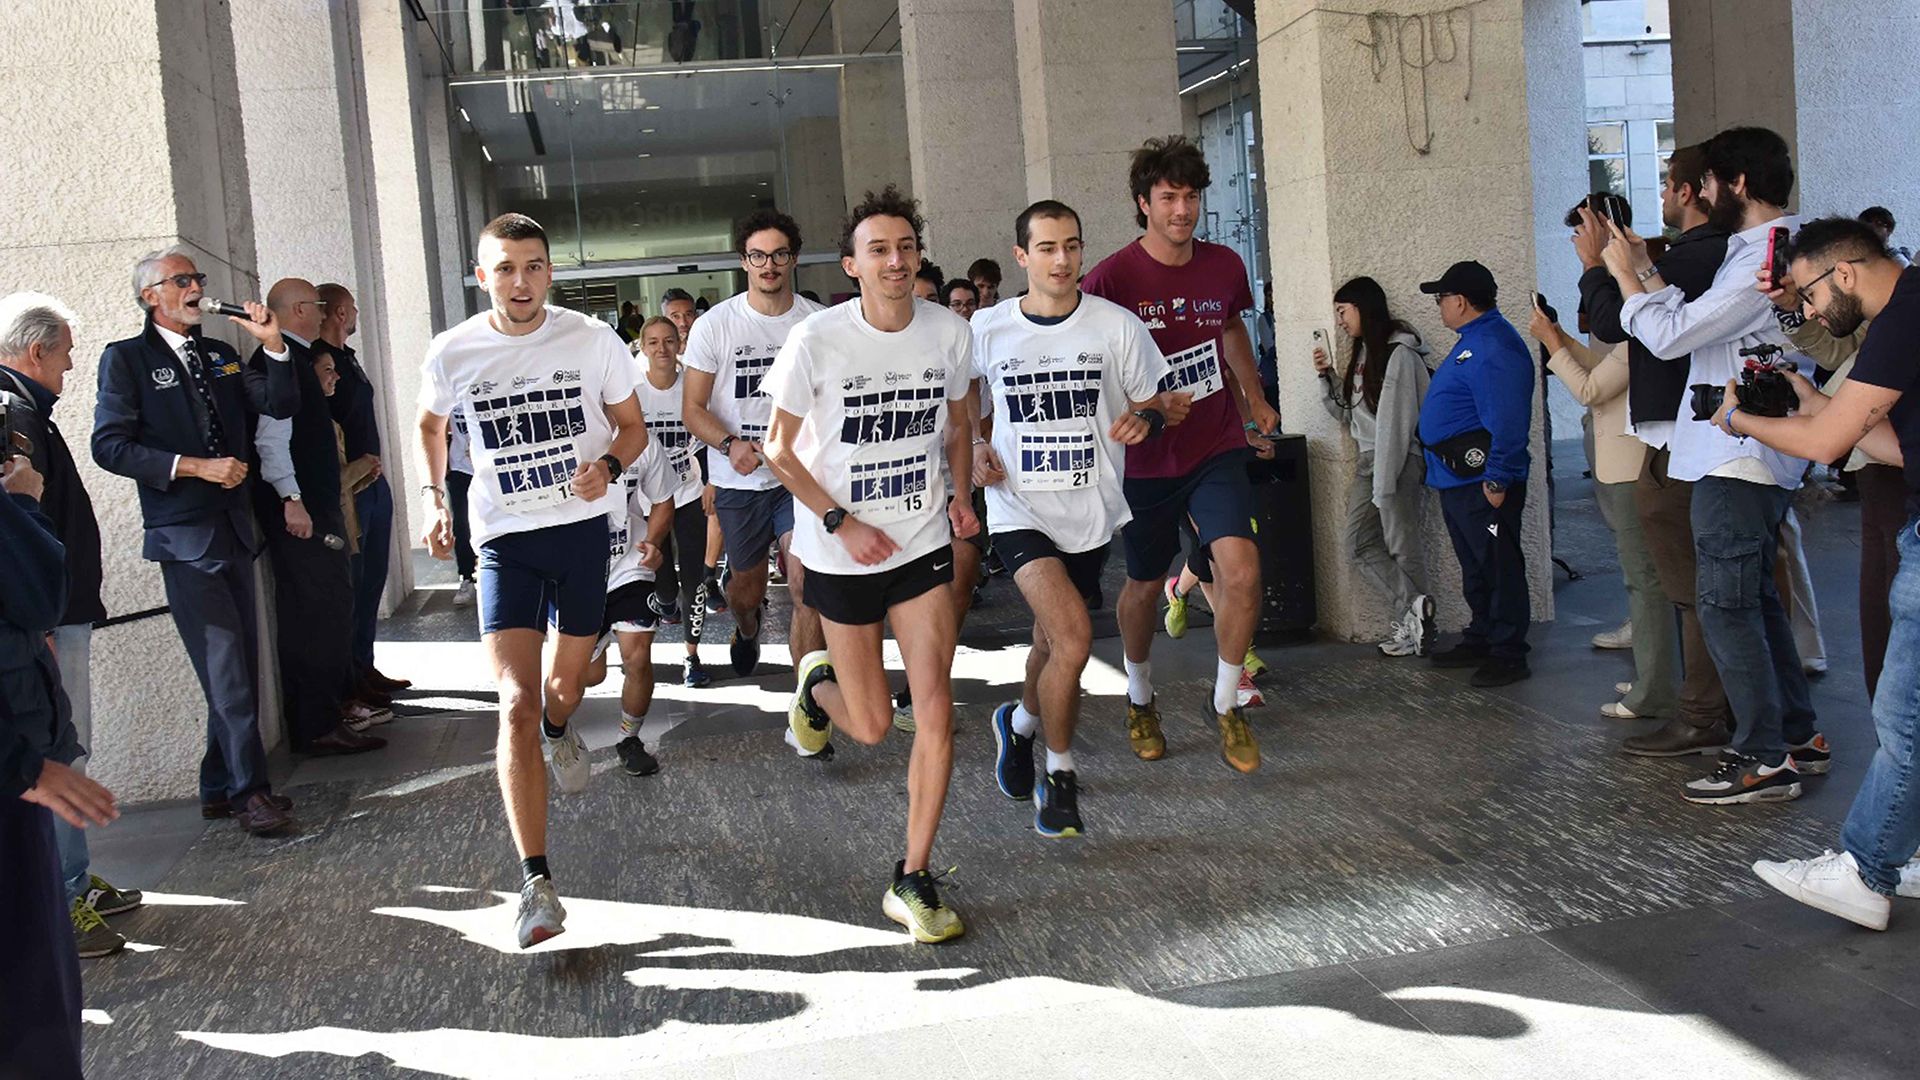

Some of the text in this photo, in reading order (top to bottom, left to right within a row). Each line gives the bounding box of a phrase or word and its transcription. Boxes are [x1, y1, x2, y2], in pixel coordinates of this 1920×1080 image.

[1138, 302, 1166, 316] iren
[1205, 379, 1213, 393] 2
[553, 420, 585, 437] 20 25
[908, 417, 935, 435] 20 25
[915, 479, 926, 490] 25
[1073, 471, 1089, 487] 21
[904, 494, 923, 511] 15
[690, 582, 708, 638] adidas
